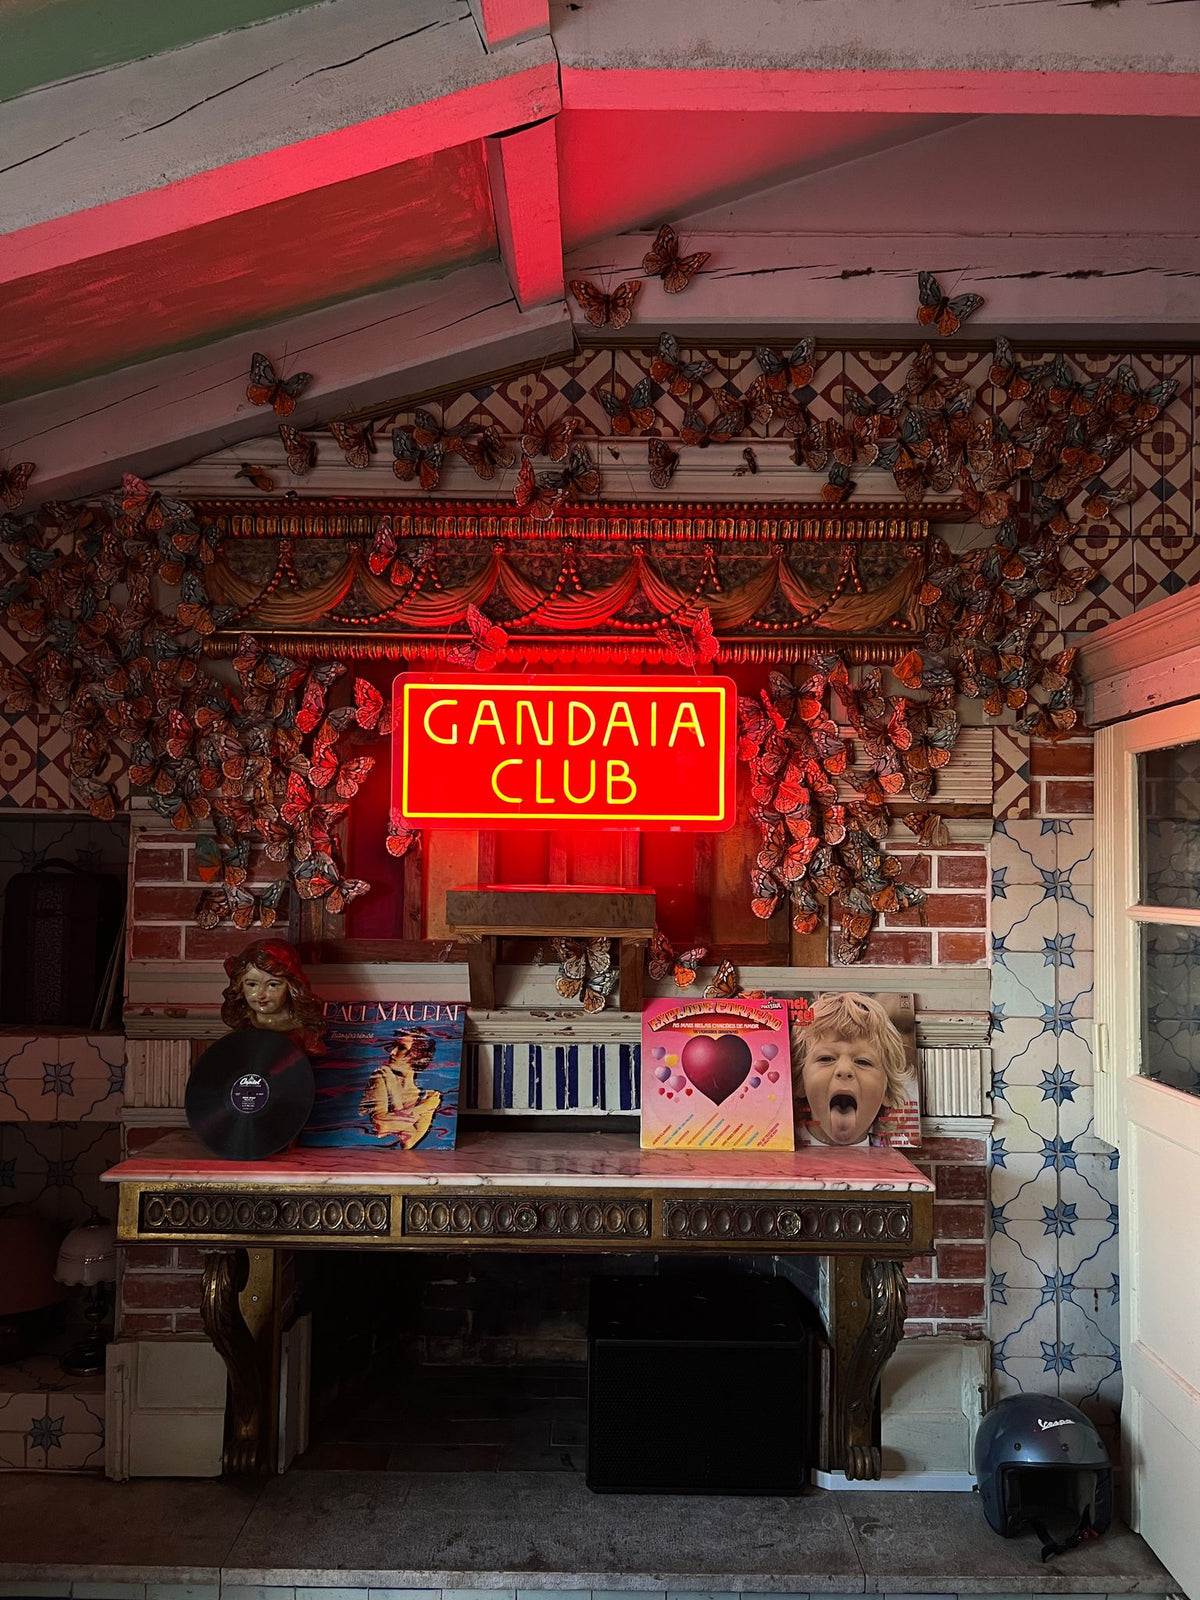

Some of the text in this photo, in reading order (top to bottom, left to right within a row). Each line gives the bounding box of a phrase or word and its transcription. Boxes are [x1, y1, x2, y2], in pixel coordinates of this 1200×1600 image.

[423, 699, 706, 747] GANDAIA
[491, 758, 637, 804] CLUB
[323, 1002, 466, 1021] PAUL MAURIAT
[648, 1001, 715, 1031] EXPLODE
[239, 1078, 262, 1086] Capitol
[1037, 1418, 1076, 1431] Vespa
